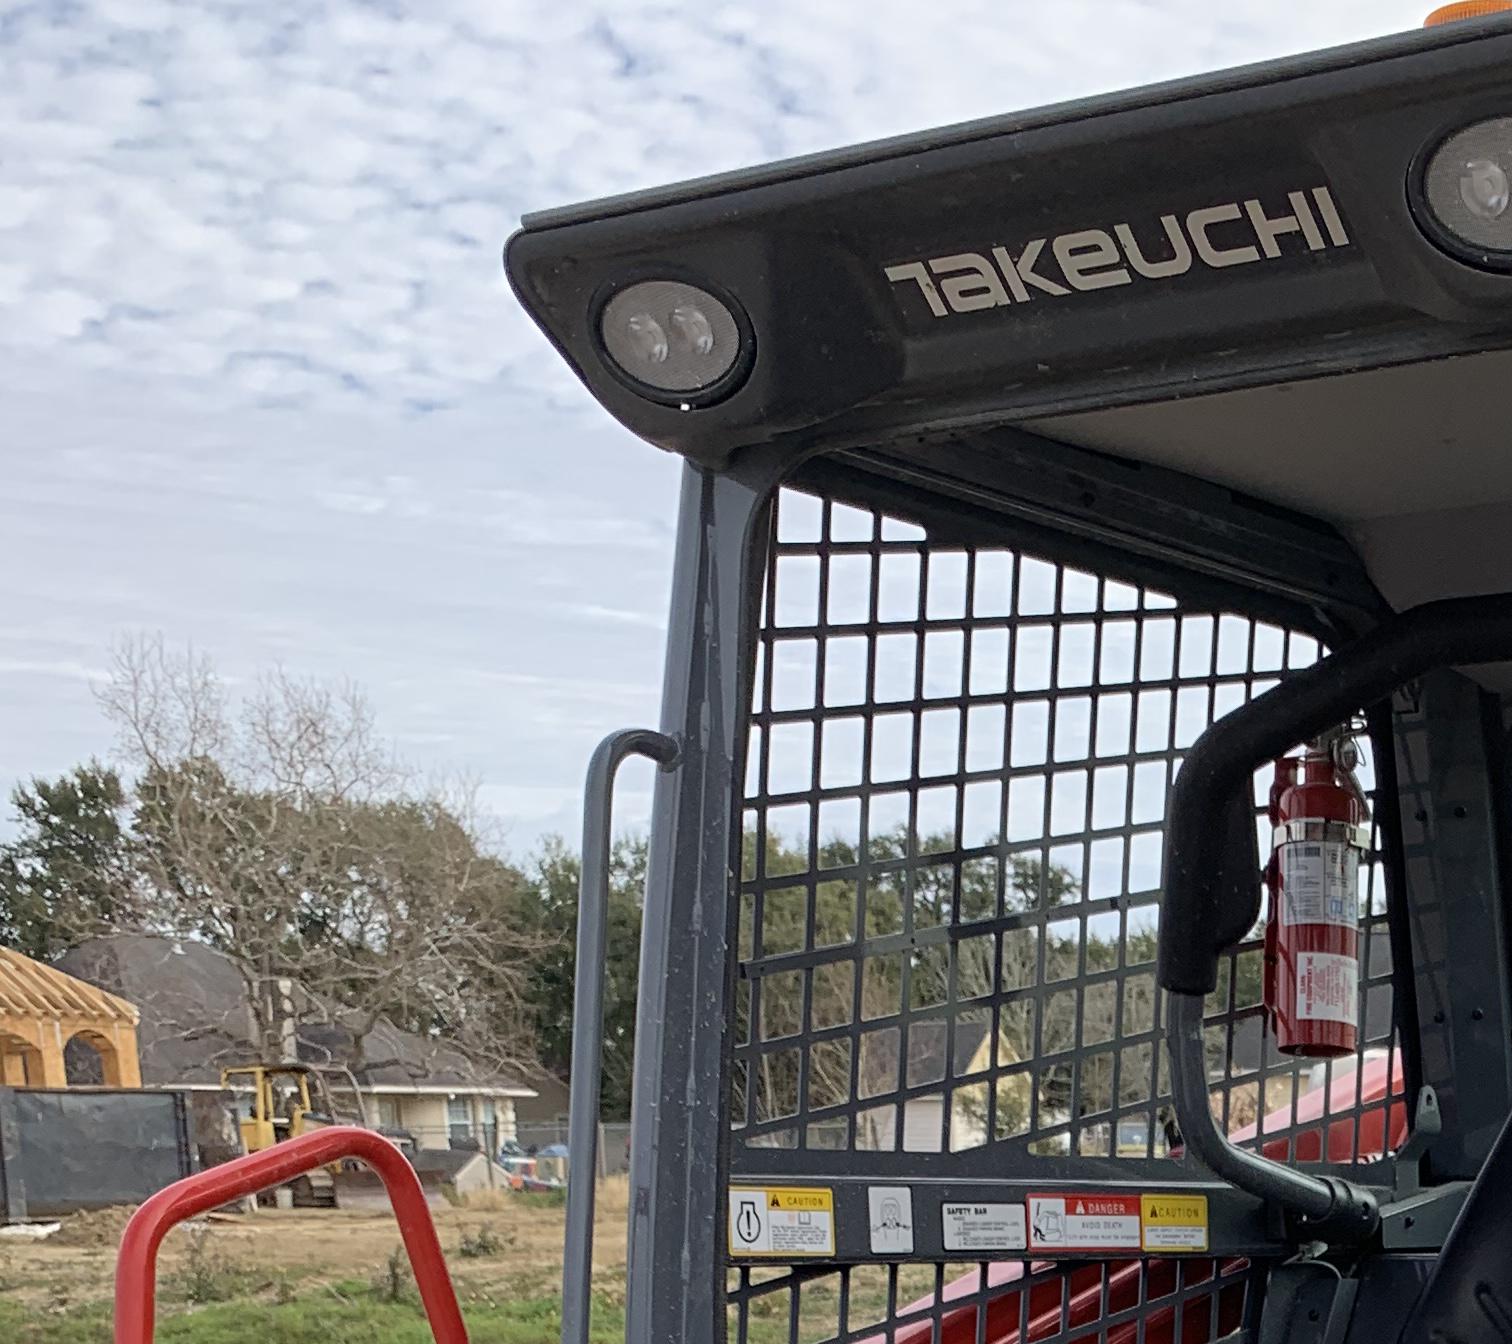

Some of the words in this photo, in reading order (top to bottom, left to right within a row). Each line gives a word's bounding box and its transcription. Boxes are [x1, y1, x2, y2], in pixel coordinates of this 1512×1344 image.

[787, 1196, 823, 1207] CAUTION
[947, 1207, 971, 1215] SAFETY
[974, 1207, 988, 1215] BAR
[1088, 1203, 1126, 1215] DANGER
[1159, 1207, 1199, 1218] CAUTION
